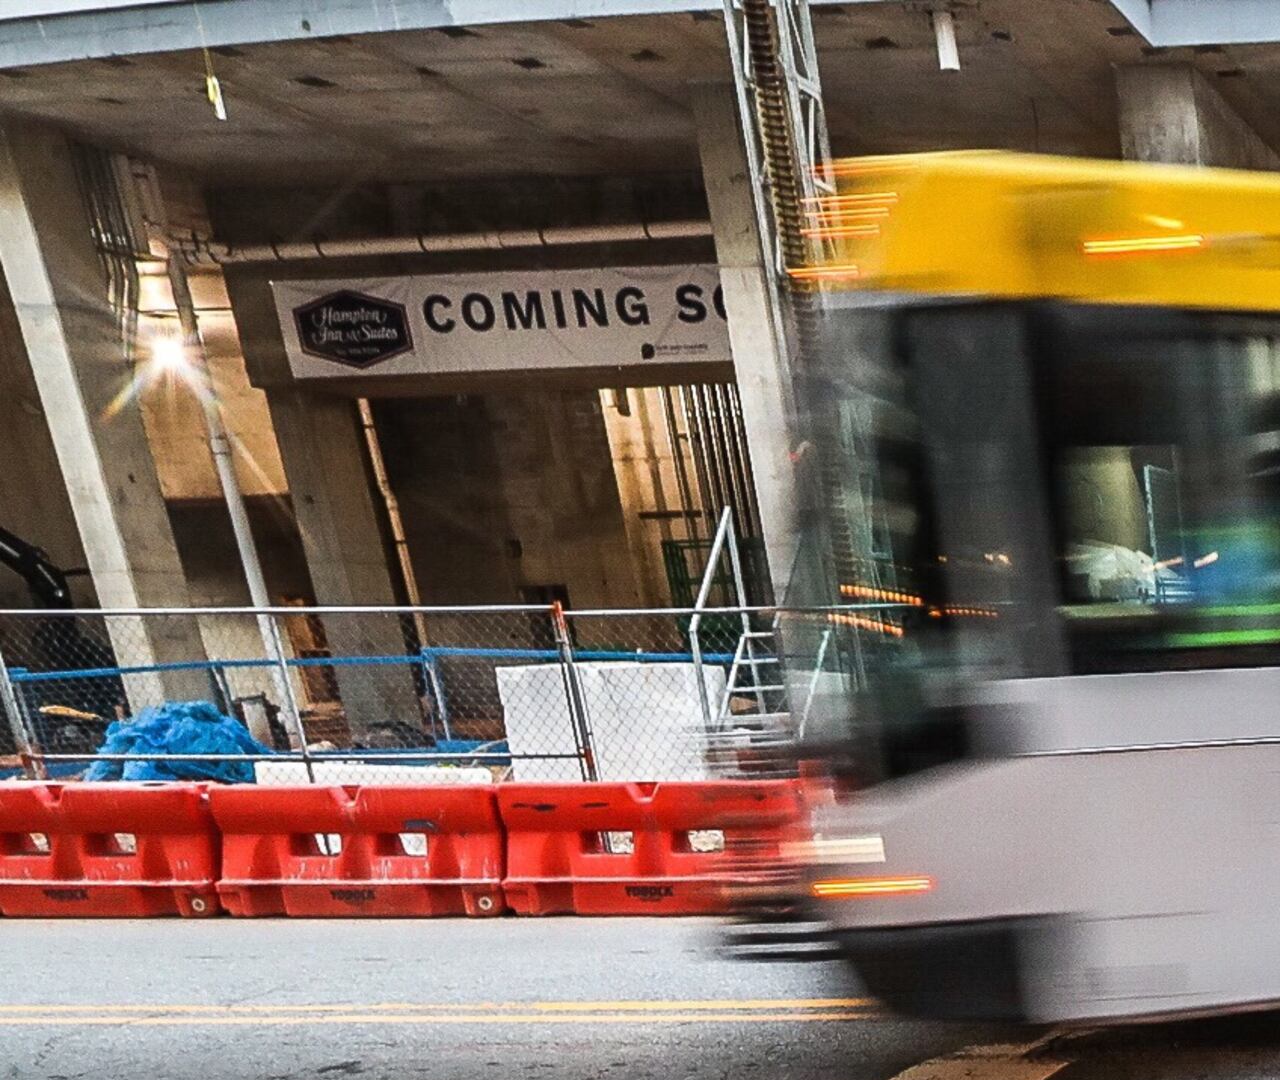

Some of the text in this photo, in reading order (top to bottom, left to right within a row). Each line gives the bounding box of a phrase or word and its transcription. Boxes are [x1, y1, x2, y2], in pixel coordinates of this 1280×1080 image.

[312, 307, 387, 327] Hampton
[423, 286, 650, 334] COMING
[312, 326, 343, 344] Inn
[361, 324, 398, 340] Suites
